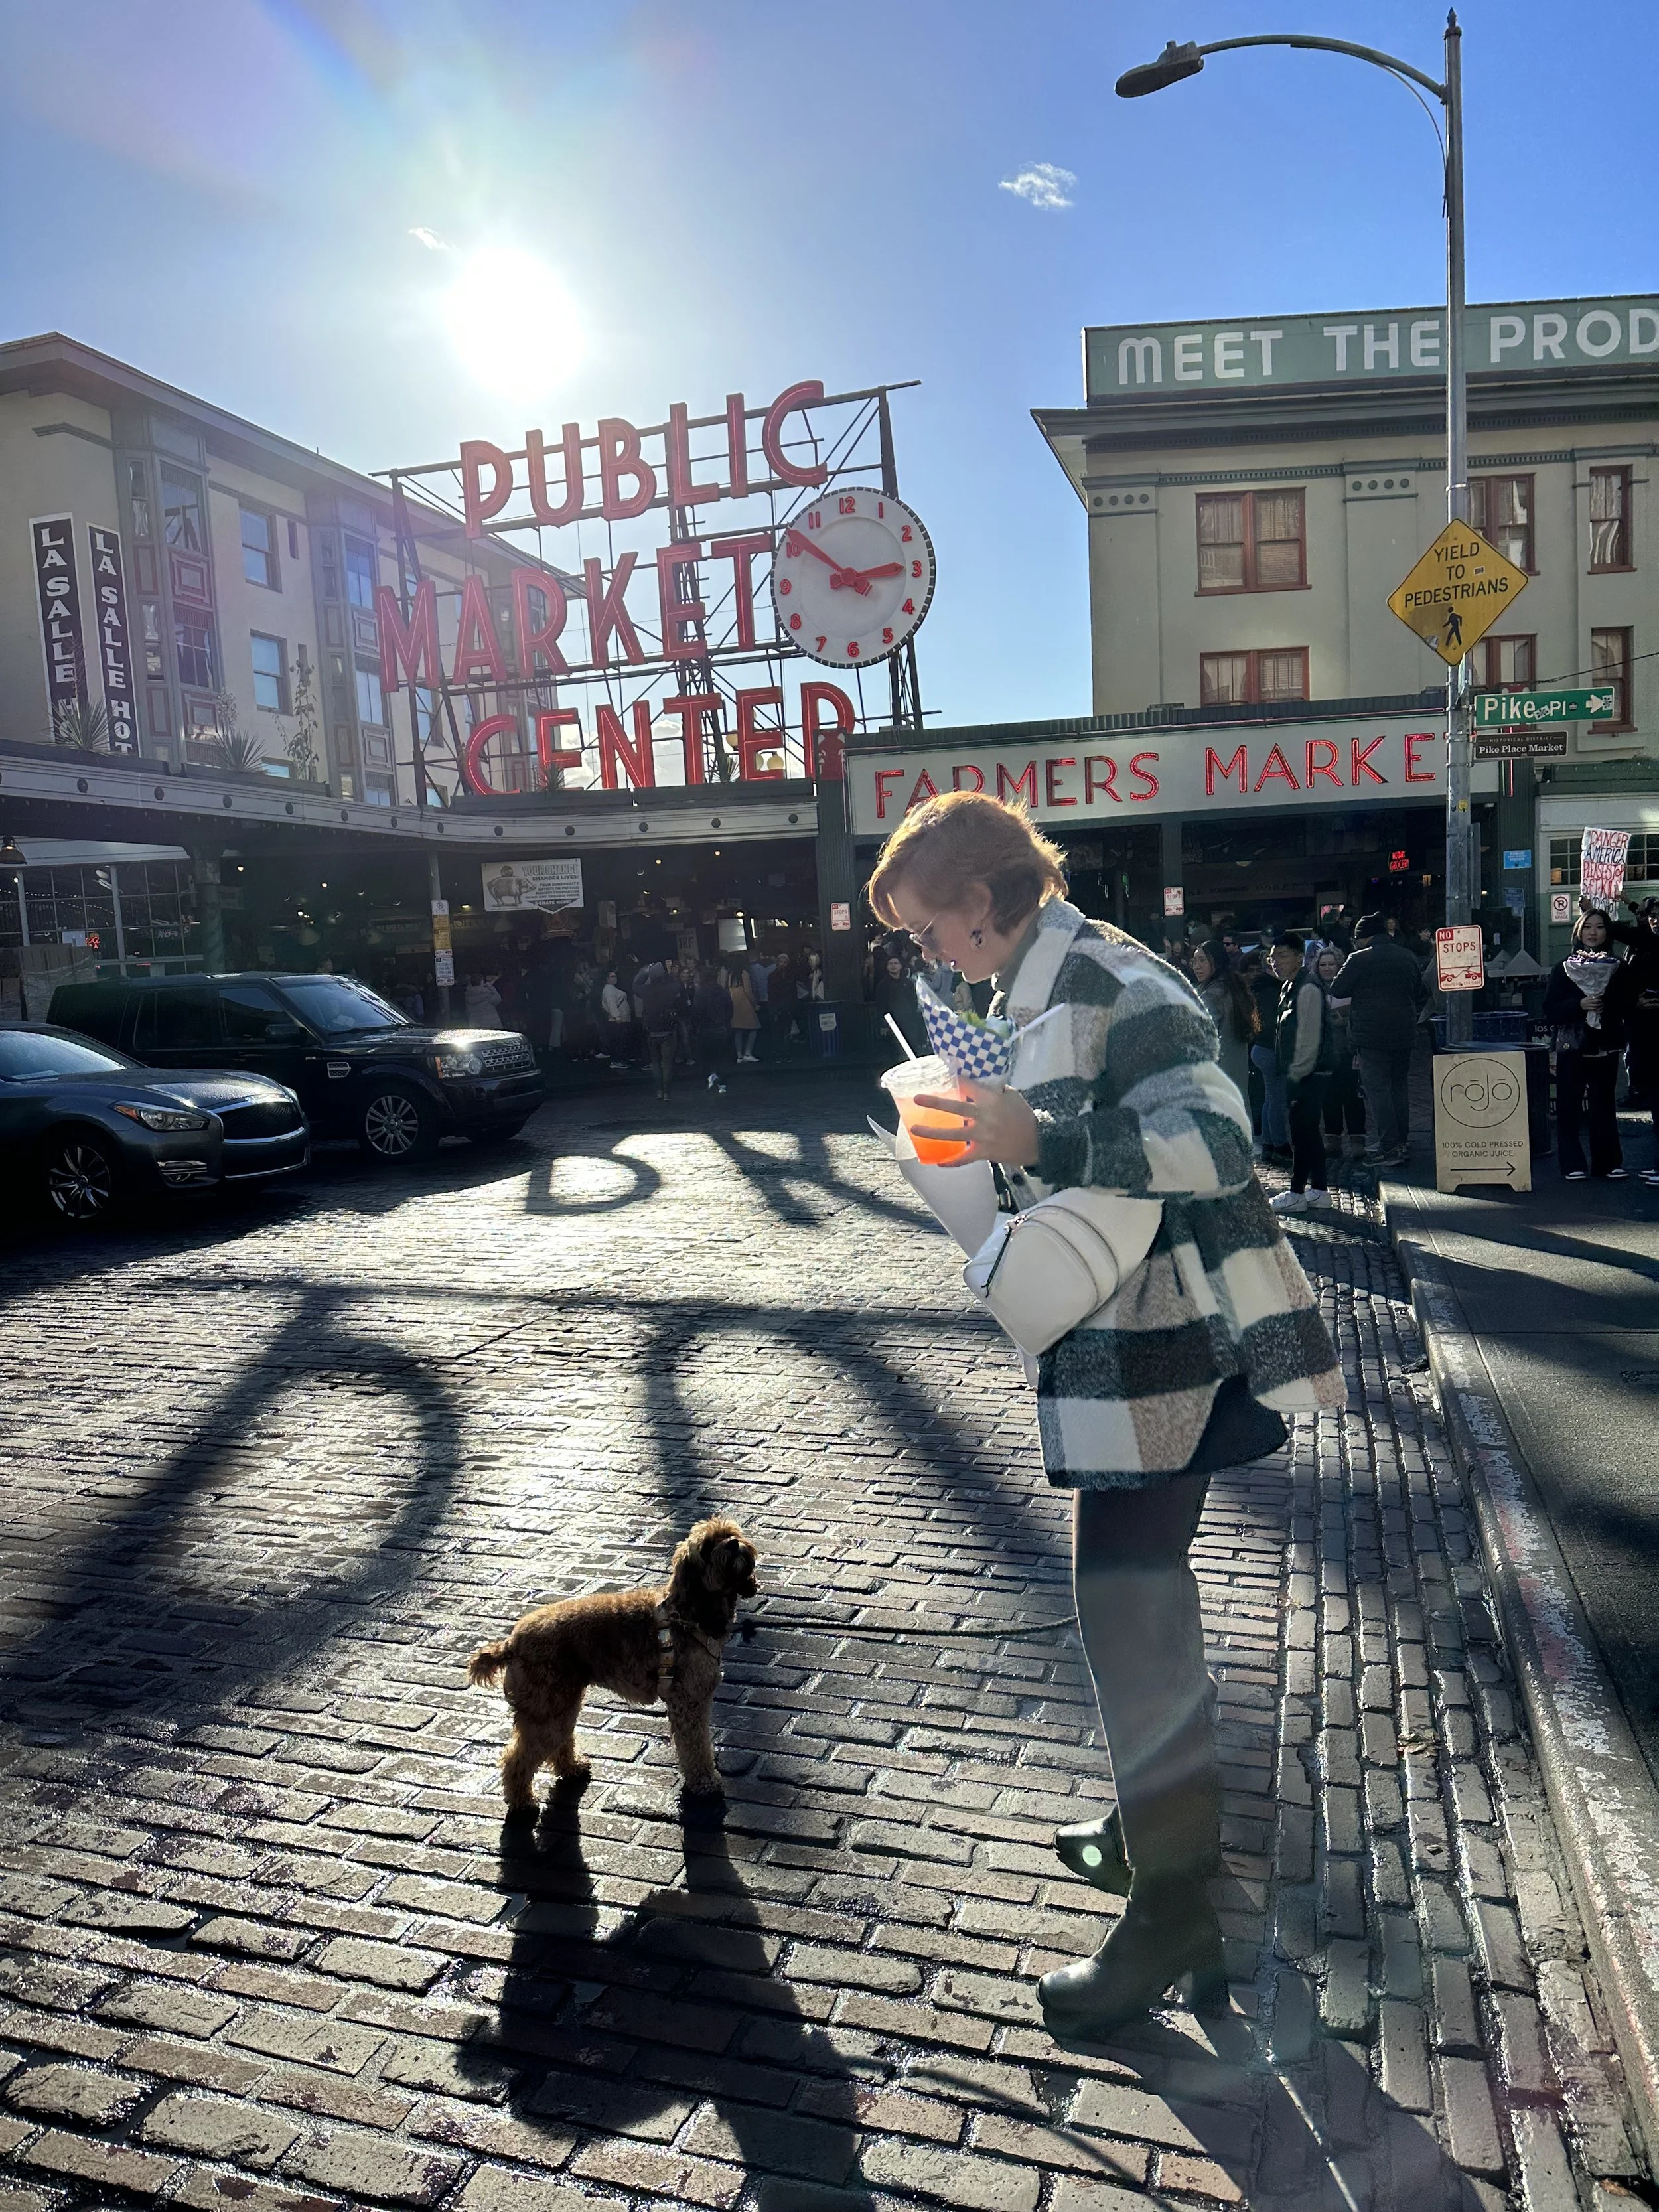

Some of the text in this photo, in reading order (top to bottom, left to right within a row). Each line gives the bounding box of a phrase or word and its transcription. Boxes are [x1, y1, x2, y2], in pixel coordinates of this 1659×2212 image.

[1118, 308, 1659, 385] MEET THE PROD
[460, 380, 828, 538] PUBLIC
[839, 496, 855, 514] 12
[878, 502, 884, 519] 1
[808, 511, 820, 529] 11
[901, 525, 912, 542] 2
[41, 528, 67, 569] LA
[96, 532, 117, 575] LA
[786, 541, 801, 557] 10
[1434, 542, 1479, 562] YIELD
[912, 560, 922, 577] 3
[1447, 564, 1465, 581] TO
[780, 579, 792, 595] 9
[1405, 577, 1508, 608] PEDESTRIANS
[375, 534, 771, 692] MARKET
[902, 598, 915, 614] 4
[46, 576, 76, 683] SALLE
[790, 613, 802, 629] 8
[101, 585, 127, 689] SALLE
[883, 627, 893, 643] 5
[816, 636, 827, 652] 7
[847, 642, 859, 658] 6
[1484, 697, 1567, 721] Pike Pl
[1479, 743, 1563, 754] Pike Place Market
[1205, 731, 1476, 795] MARKE
[1589, 830, 1628, 849] DANGER
[1585, 846, 1626, 864] AMERICA
[522, 864, 579, 876] YOUR CHANGE
[1439, 931, 1451, 940] NO
[1443, 942, 1476, 953] STOPS
